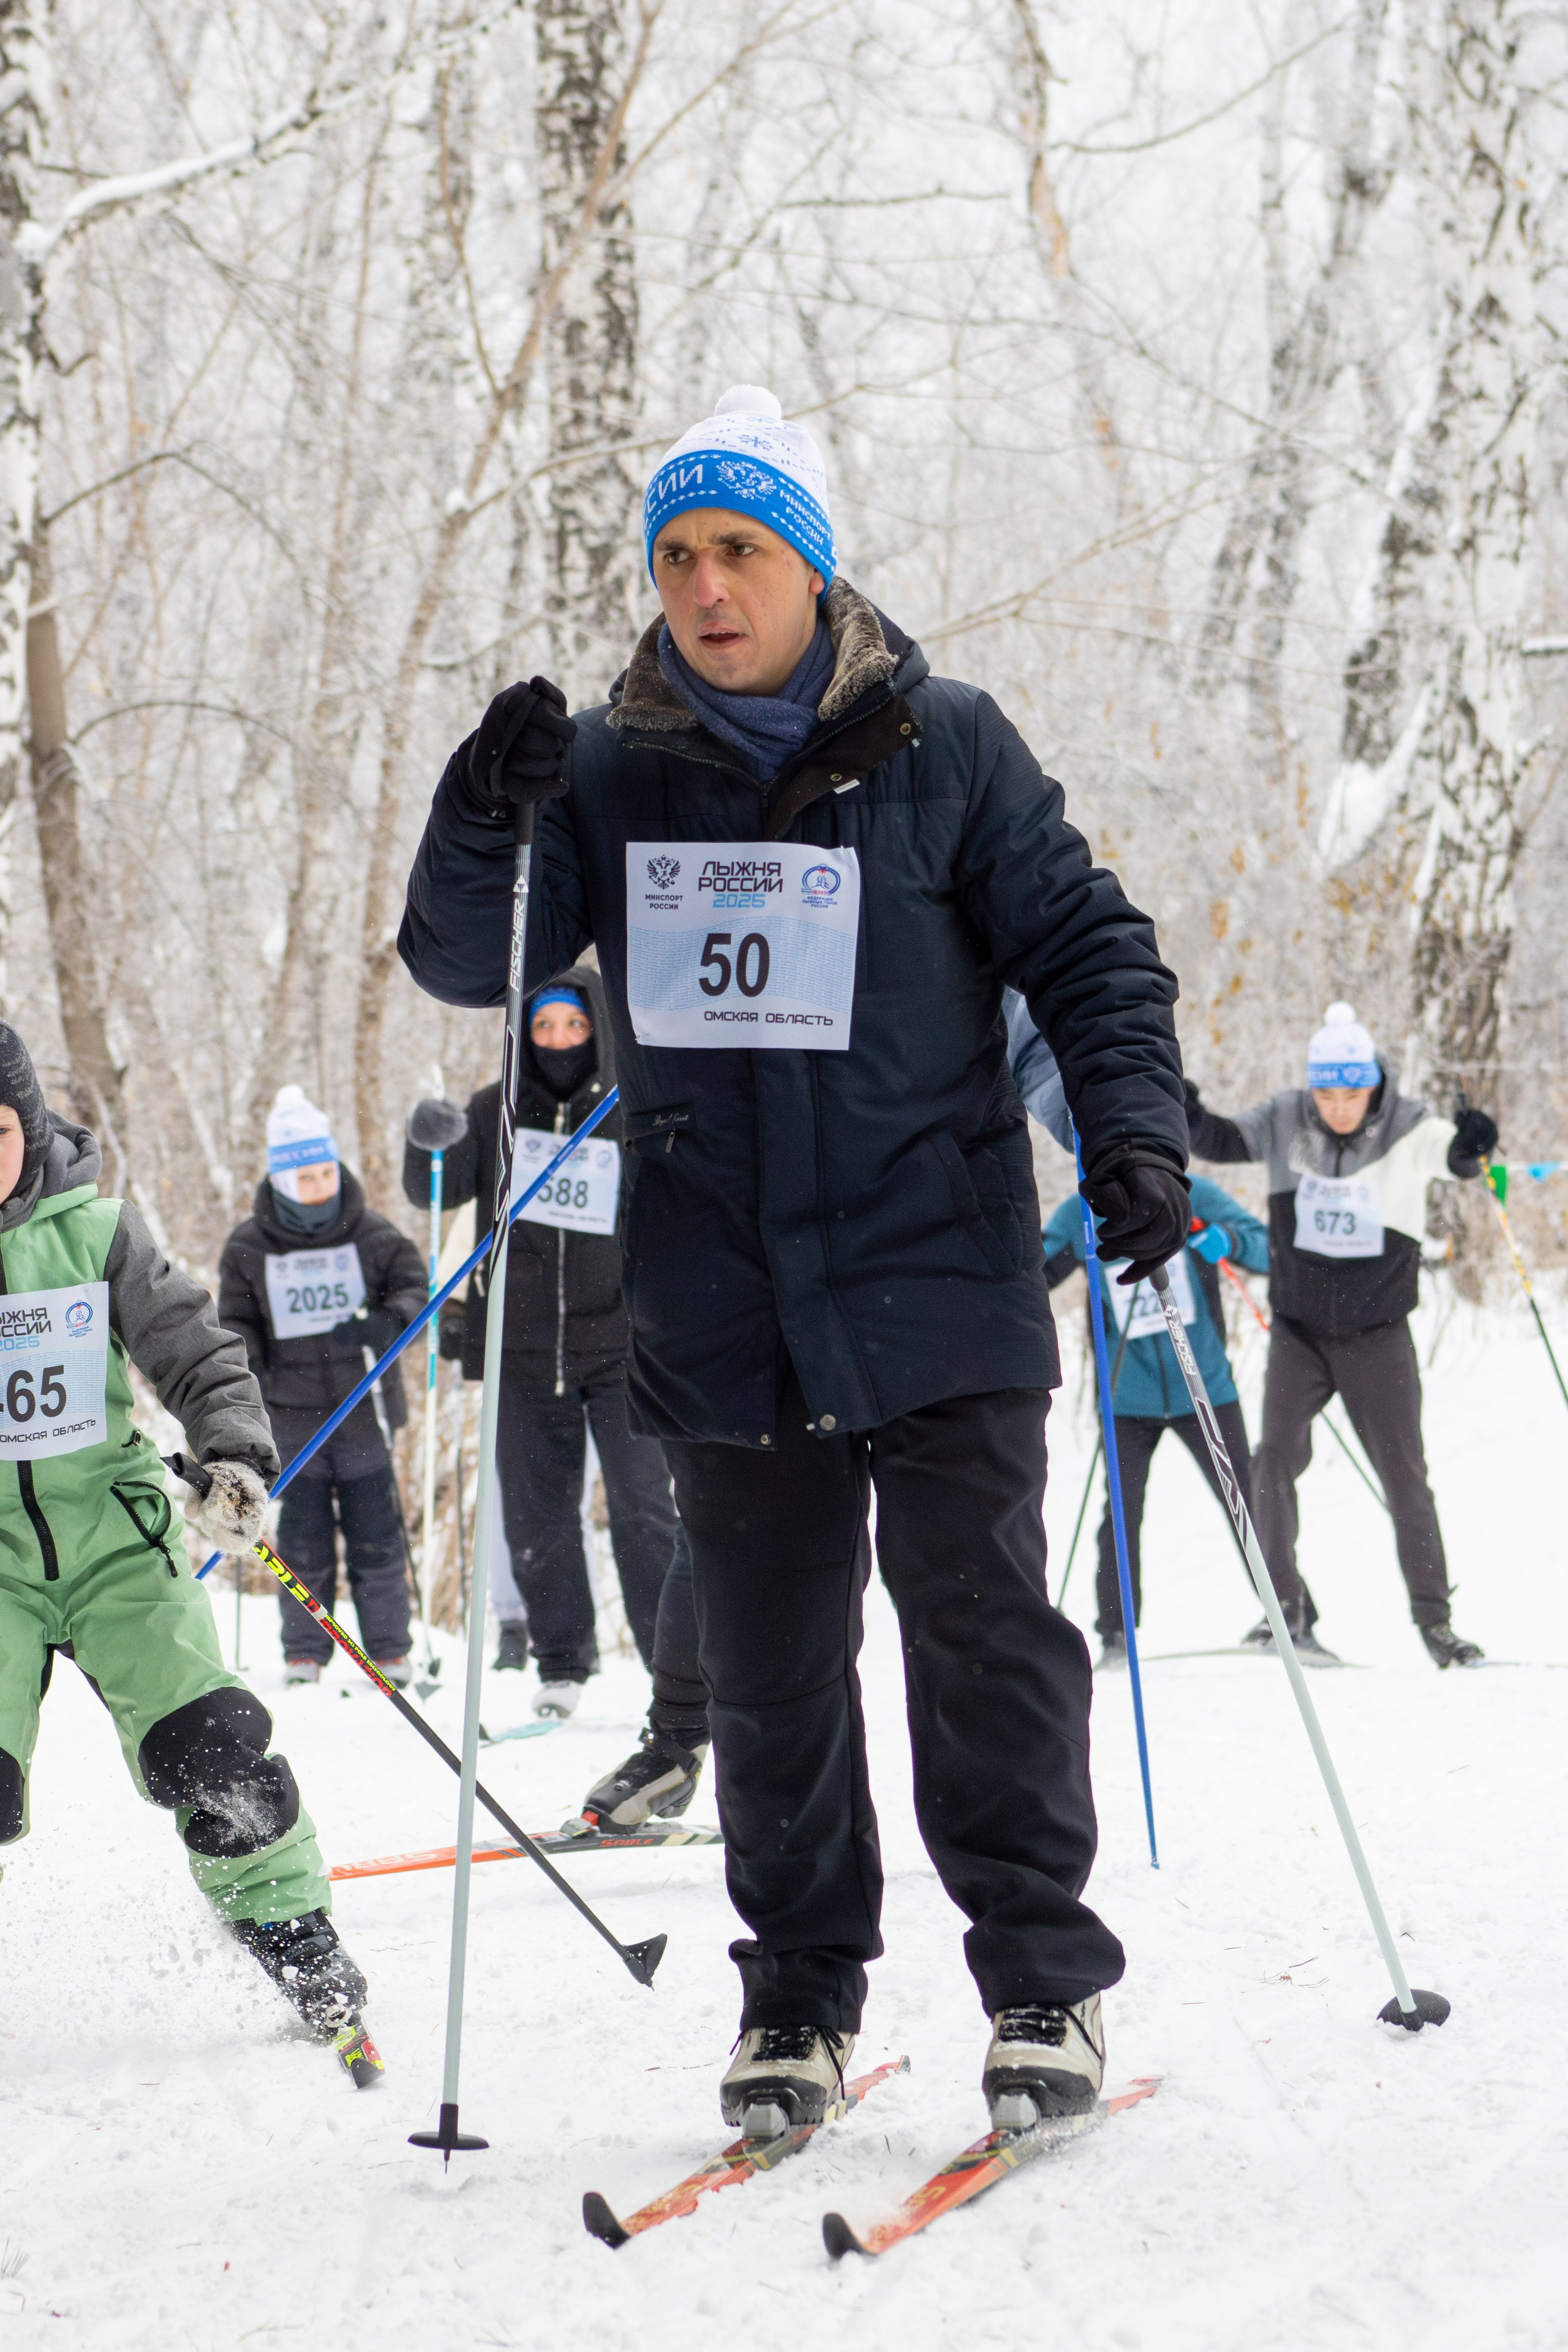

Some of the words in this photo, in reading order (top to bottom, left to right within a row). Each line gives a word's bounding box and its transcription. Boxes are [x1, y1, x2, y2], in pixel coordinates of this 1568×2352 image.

[644, 464, 703, 521] СИИ
[780, 489, 831, 540] МИНСПОРТ
[786, 507, 824, 545] РОССИИ
[702, 861, 782, 876] ЛЫЖНЯ
[698, 876, 783, 893] РОССИИ
[712, 893, 766, 908] 2025
[510, 898, 525, 992] FISCHER
[698, 932, 770, 997] 50
[704, 1011, 758, 1022] ОМСКАЯ
[765, 1013, 834, 1026] ОБЛАСТЬ
[537, 1177, 589, 1208] 588
[1314, 1210, 1355, 1235] 673
[286, 1283, 349, 1313] 2025
[0, 1320, 52, 1338] ССИИ
[1168, 1319, 1197, 1375] FISCHER
[0, 1365, 67, 1423] 65
[0, 1431, 48, 1443] ОМСКАЯ
[53, 1419, 96, 1437] ОБЛАСТЬ
